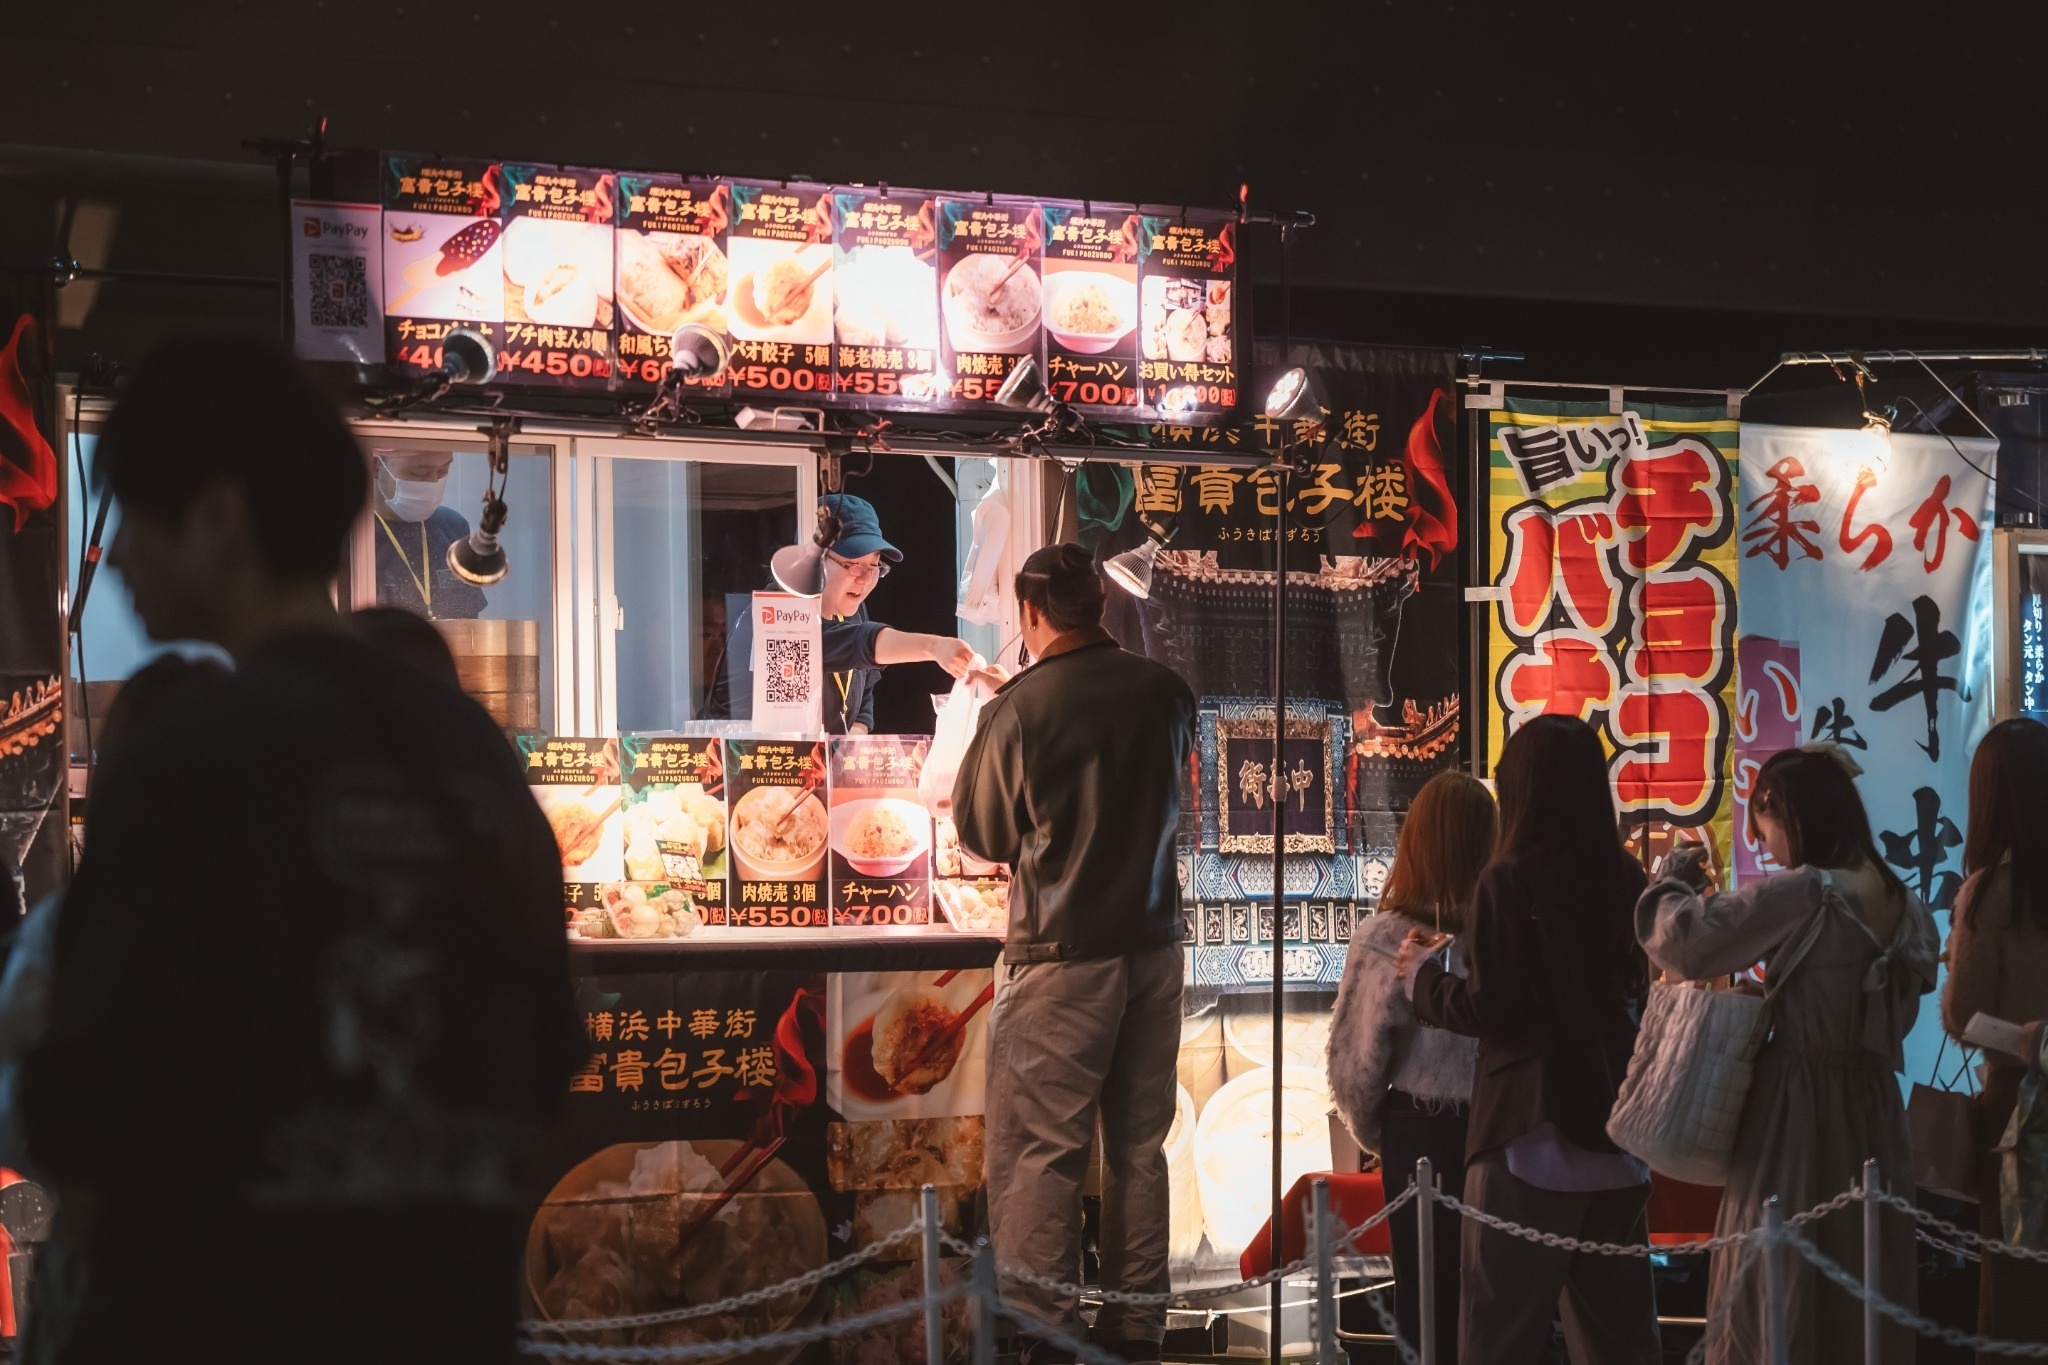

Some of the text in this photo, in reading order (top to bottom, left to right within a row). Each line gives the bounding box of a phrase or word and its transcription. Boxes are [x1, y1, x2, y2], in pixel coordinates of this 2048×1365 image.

[413, 203, 432, 211] FUKI
[322, 222, 368, 239] PayPay
[643, 221, 661, 230] FUKI
[966, 244, 984, 252] FUKI
[1063, 248, 1078, 257] FUKI
[1163, 258, 1211, 268] FUKI PAOZUROU
[398, 319, 493, 340] チョコバ
[505, 324, 607, 351] プチ肉まん3個
[619, 333, 673, 357] 和風ち
[957, 353, 1003, 375] 肉焼売
[1048, 356, 1128, 381] チャーハン
[1139, 361, 1235, 384] お買い得セット
[1742, 456, 1981, 573] 柔らか
[1218, 527, 1321, 543] ふうきぱずろう
[776, 610, 811, 624] PayPay
[1613, 446, 1720, 810] チョコ
[542, 774, 595, 783] FUKI PAOZUROU
[647, 775, 699, 783] FUKI PAOZUROU
[752, 777, 768, 785] FUKI
[742, 882, 816, 903] 肉焼売 3個
[842, 881, 920, 902] チャーハン
[585, 1008, 756, 1042] 横浜中華街
[631, 1098, 711, 1111] ふうきぱずろう
